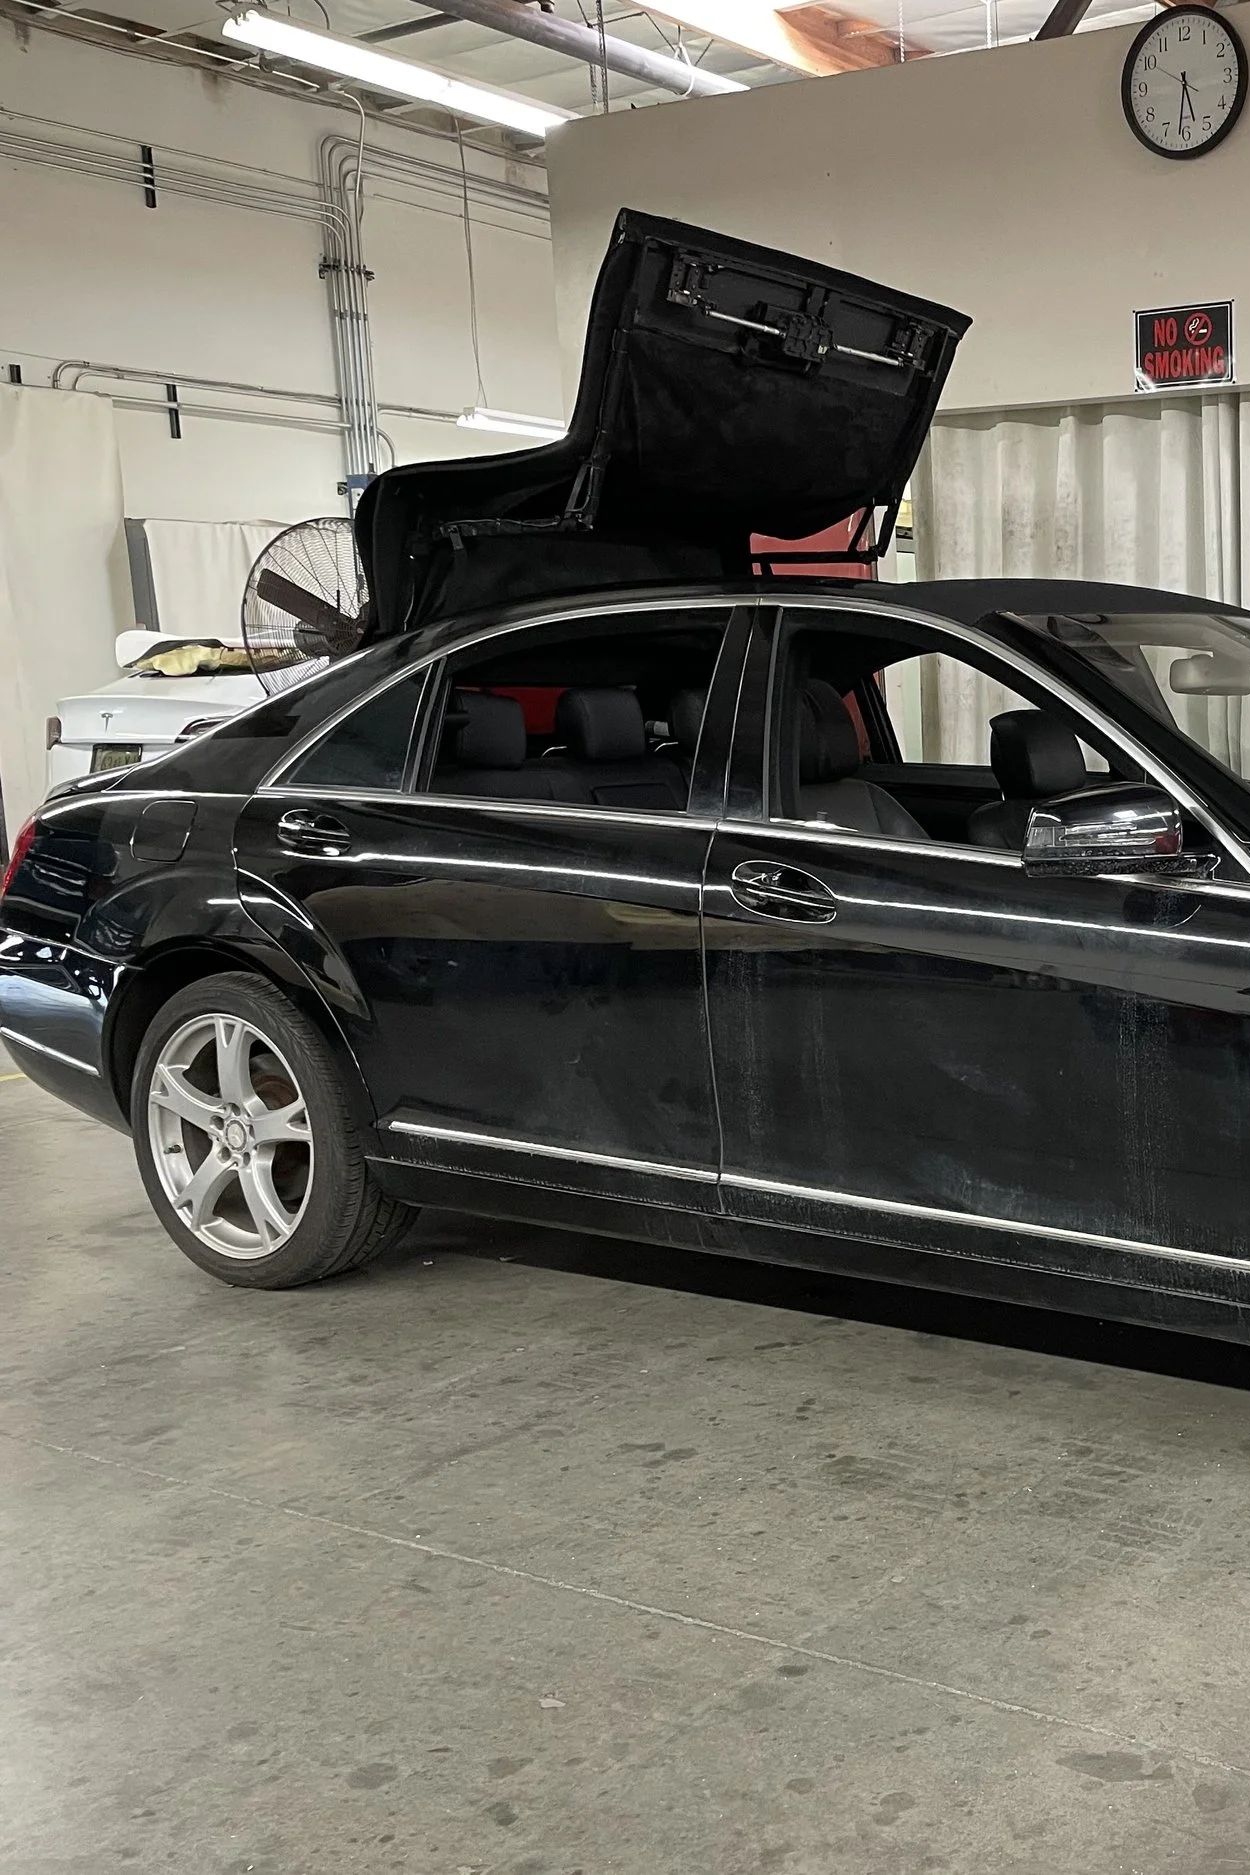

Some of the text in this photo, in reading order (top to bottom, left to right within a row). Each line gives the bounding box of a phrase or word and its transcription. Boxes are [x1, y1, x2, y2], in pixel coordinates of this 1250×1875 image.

[1178, 25, 1191, 42] 12
[1159, 37, 1168, 53] 11
[1216, 43, 1225, 58] 2
[1144, 54, 1157, 71] 10
[1223, 67, 1233, 84] 3
[1138, 82, 1148, 98] 9
[1217, 95, 1227, 110] 4
[1146, 107, 1155, 122] 8
[1162, 122, 1171, 137] 7
[1202, 115, 1212, 131] 5
[1181, 126, 1191, 142] 6
[1154, 317, 1178, 347] NO
[1144, 345, 1225, 379] SMOKING
